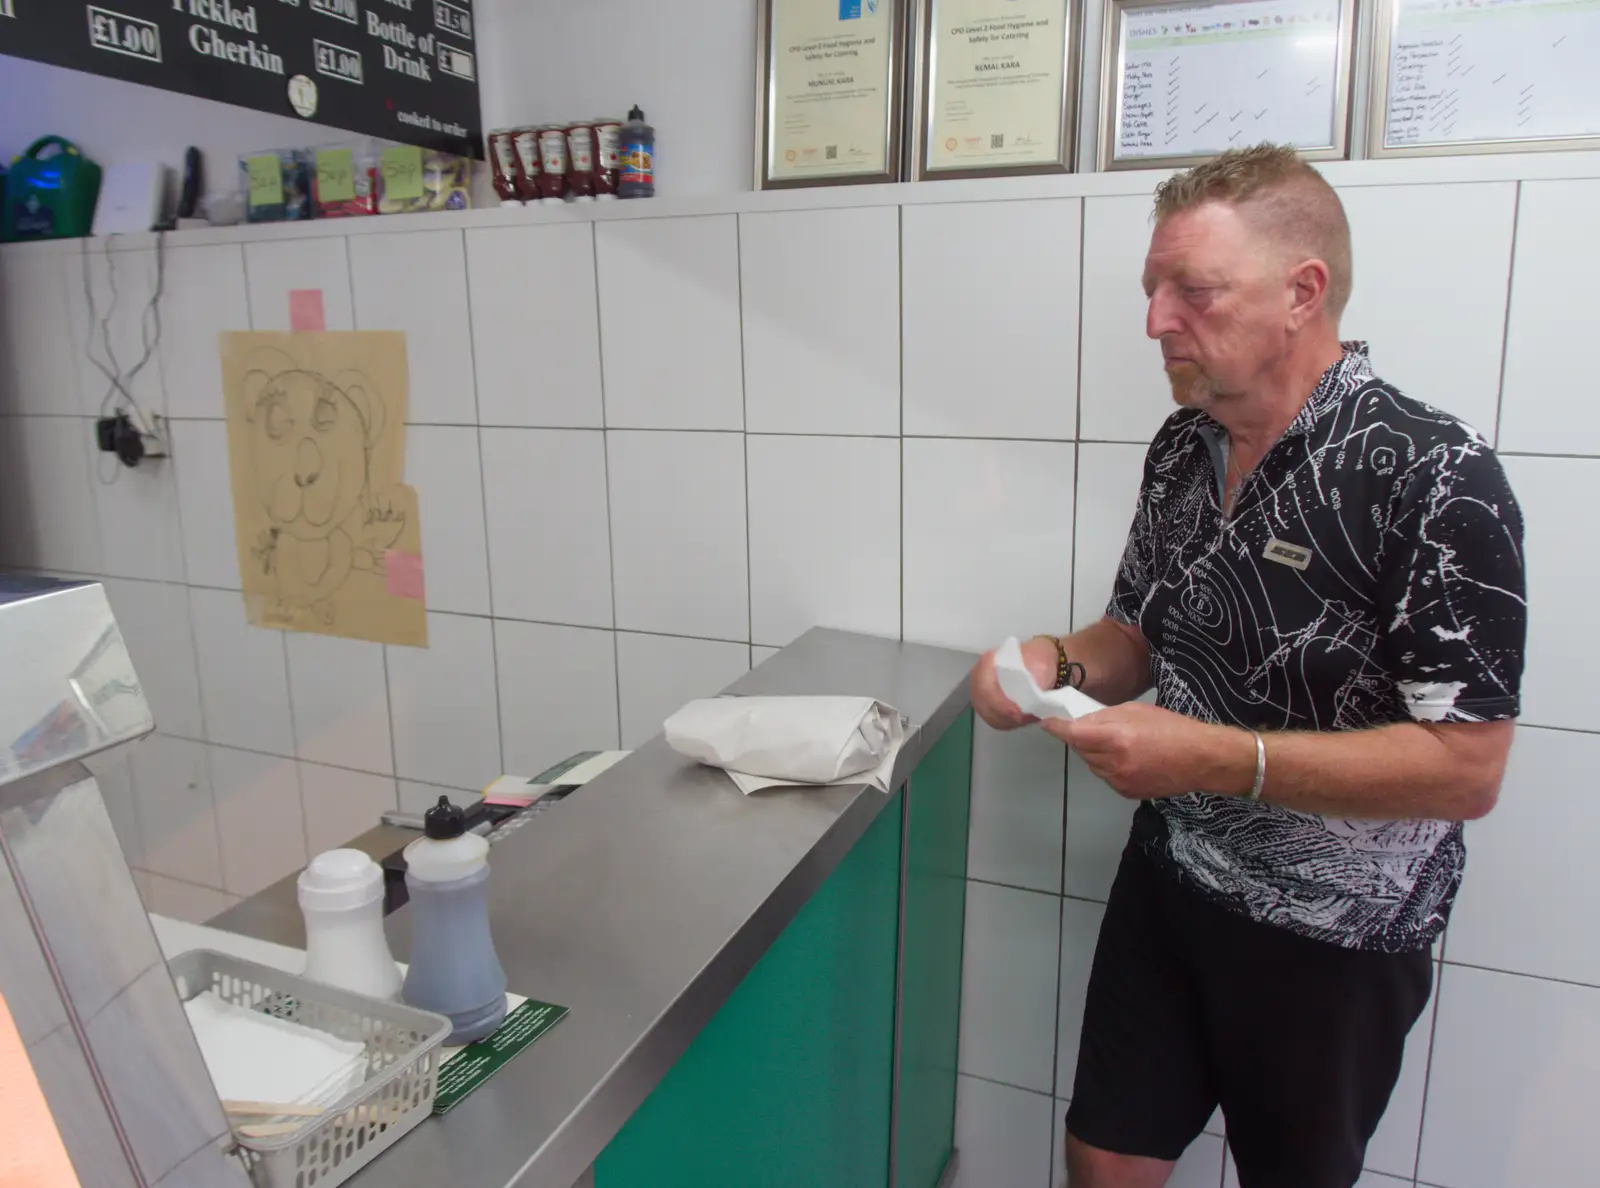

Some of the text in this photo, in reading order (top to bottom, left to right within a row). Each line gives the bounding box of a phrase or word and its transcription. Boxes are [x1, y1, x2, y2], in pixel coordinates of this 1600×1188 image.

[94, 14, 156, 54] £1.00
[365, 10, 436, 57] Bottle of
[965, 24, 982, 34] Level
[989, 22, 1005, 31] Food
[1007, 20, 1034, 30] Hygiene
[1036, 18, 1049, 26] and
[968, 31, 1029, 44] Safety for Catering
[188, 24, 285, 75] Gherkin
[318, 47, 360, 78] £1.00
[382, 44, 432, 82] Drink
[1000, 60, 1020, 70] KARA
[397, 111, 468, 138] cooked to order
[1335, 450, 1346, 470] 1024
[1330, 487, 1342, 510] 1008
[1192, 565, 1208, 579] 1004
[1167, 605, 1184, 621] 1004
[1187, 609, 1205, 626] 1000
[1162, 617, 1179, 632] 1008
[1162, 632, 1177, 644] 1012
